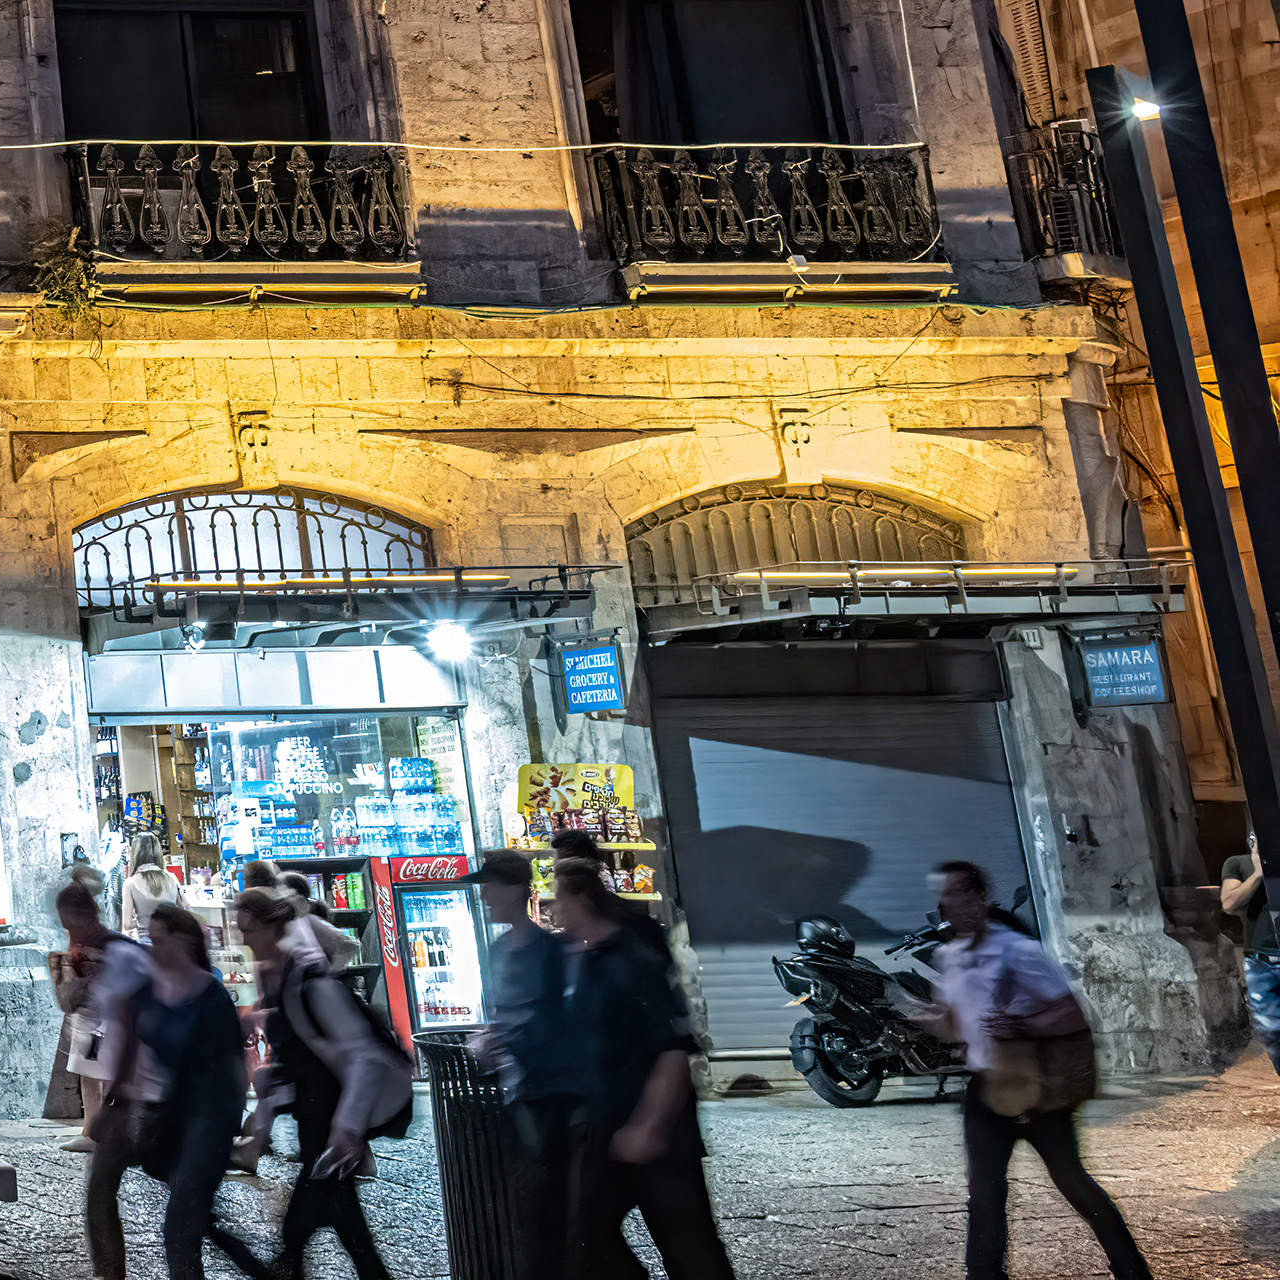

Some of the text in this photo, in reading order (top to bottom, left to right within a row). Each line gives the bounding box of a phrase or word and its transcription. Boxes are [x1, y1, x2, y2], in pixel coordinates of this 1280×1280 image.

[1025, 631, 1038, 643] 11
[574, 652, 615, 670] MICHEL
[1086, 648, 1155, 669] SAMARA
[569, 671, 608, 688] GROCERY
[1091, 671, 1152, 685] RESTAURANT
[571, 688, 619, 704] CAFETERIA
[266, 782, 344, 796] CAPPUCCINO
[400, 856, 460, 880] Coca-Cola
[374, 880, 399, 968] Coca-Cola
